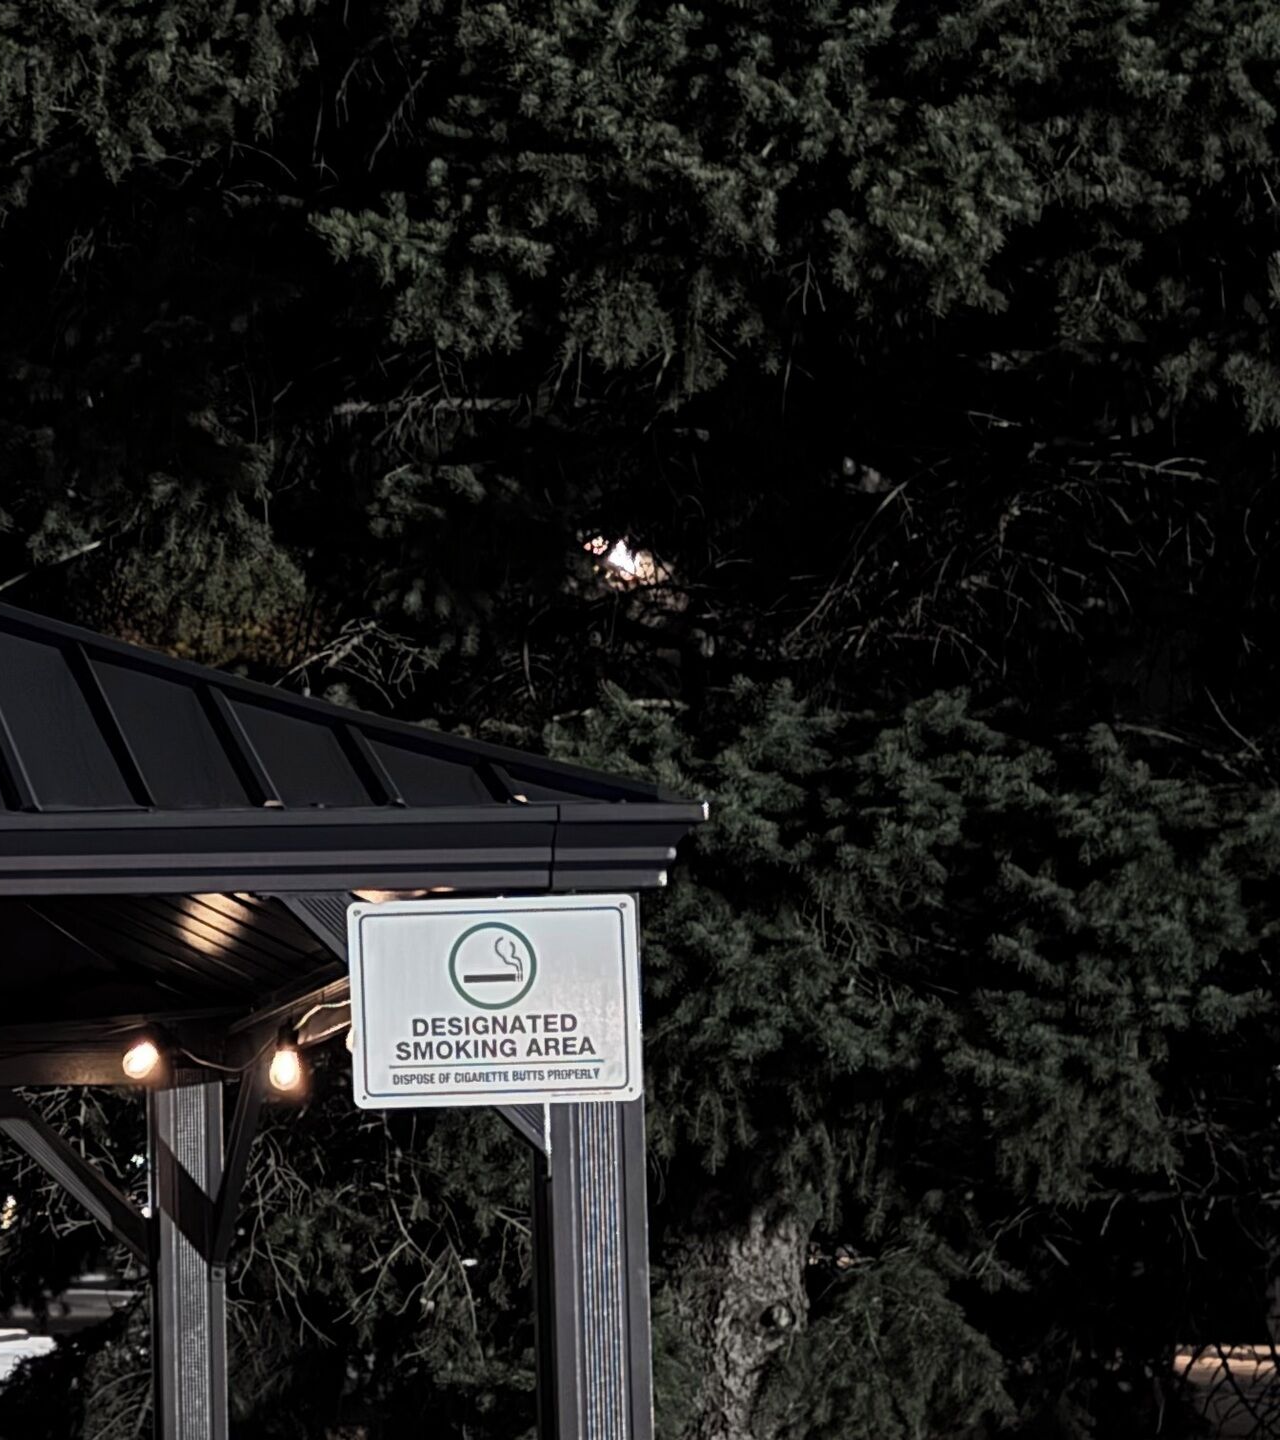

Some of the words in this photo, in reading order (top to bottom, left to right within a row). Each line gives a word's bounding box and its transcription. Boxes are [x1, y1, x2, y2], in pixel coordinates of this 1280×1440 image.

[412, 1014, 578, 1037] DESIGNATED
[395, 1039, 517, 1061] SMOKING
[526, 1036, 596, 1057] AREA
[392, 1073, 435, 1086] DISPOSE
[438, 1072, 452, 1084] OF
[454, 1070, 509, 1084] CIGARETTE
[512, 1069, 545, 1082] BUTTS
[547, 1067, 600, 1081] PROPERLY
